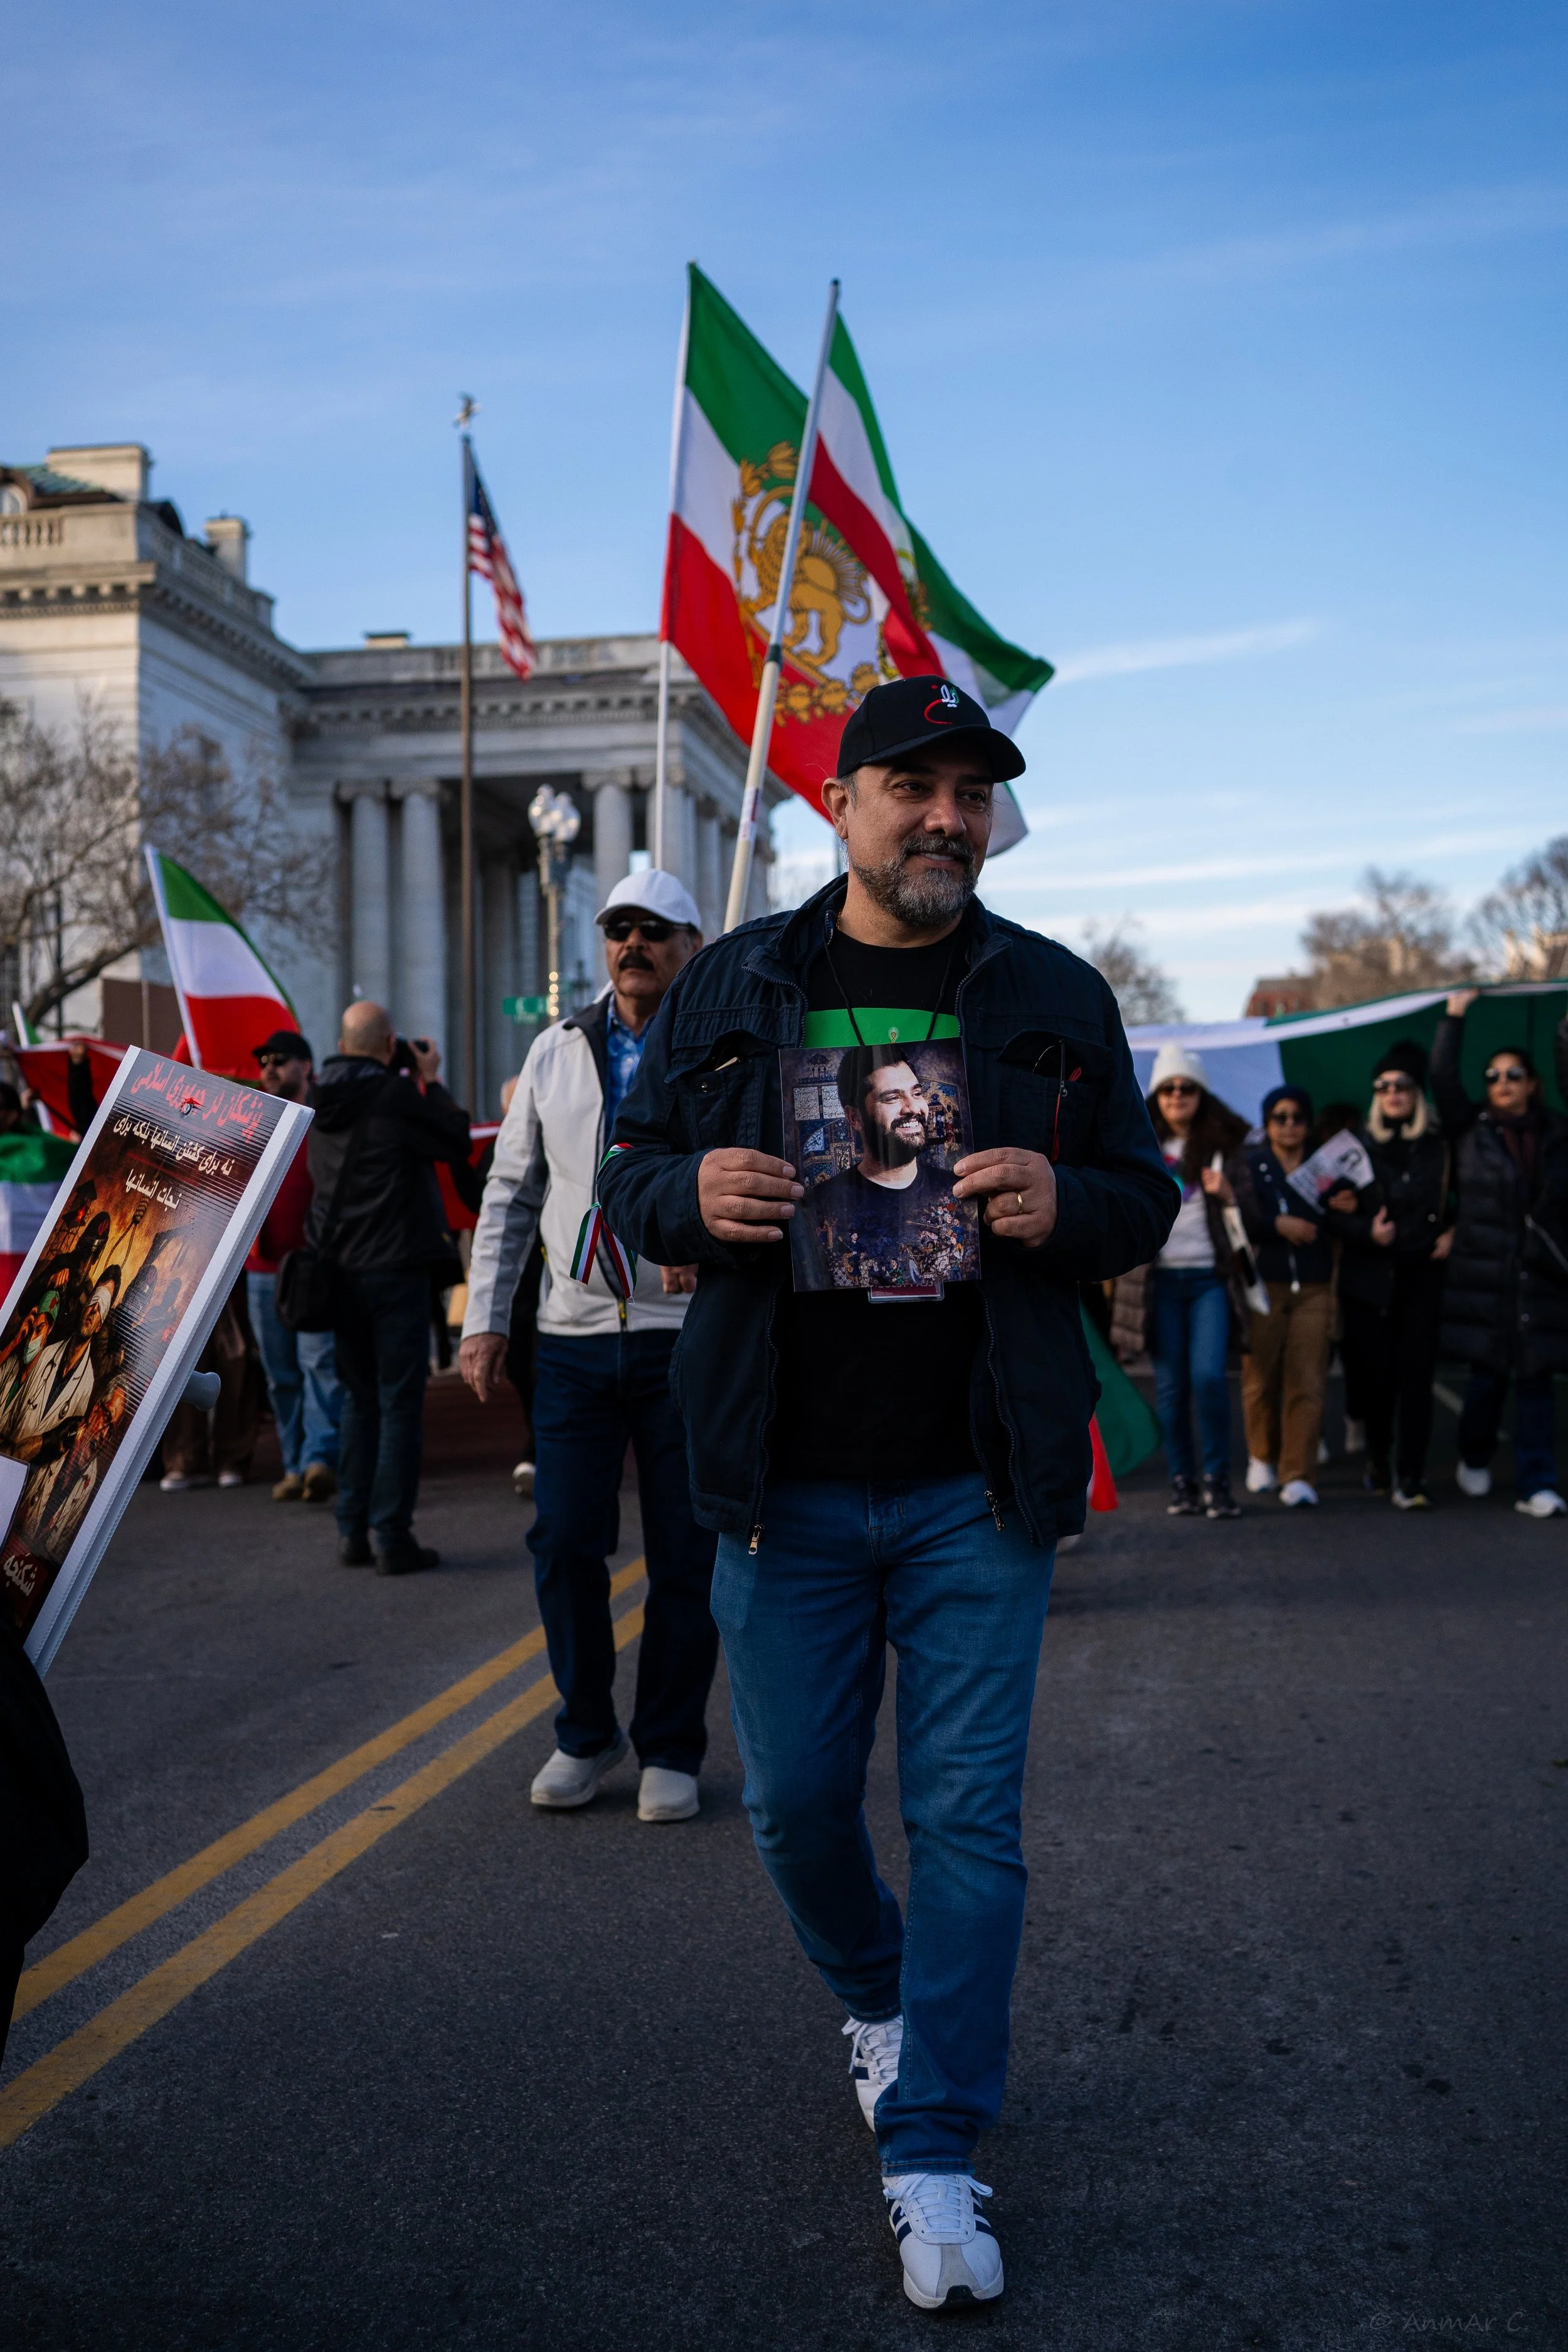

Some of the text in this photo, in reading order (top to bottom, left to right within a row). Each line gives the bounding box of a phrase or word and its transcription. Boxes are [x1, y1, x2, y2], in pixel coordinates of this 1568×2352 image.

[130, 1061, 175, 1094] اسلامی
[113, 1113, 235, 1176] نه برای کشتن انسانها بلکه برای
[125, 1168, 182, 1212] نجات انسانها
